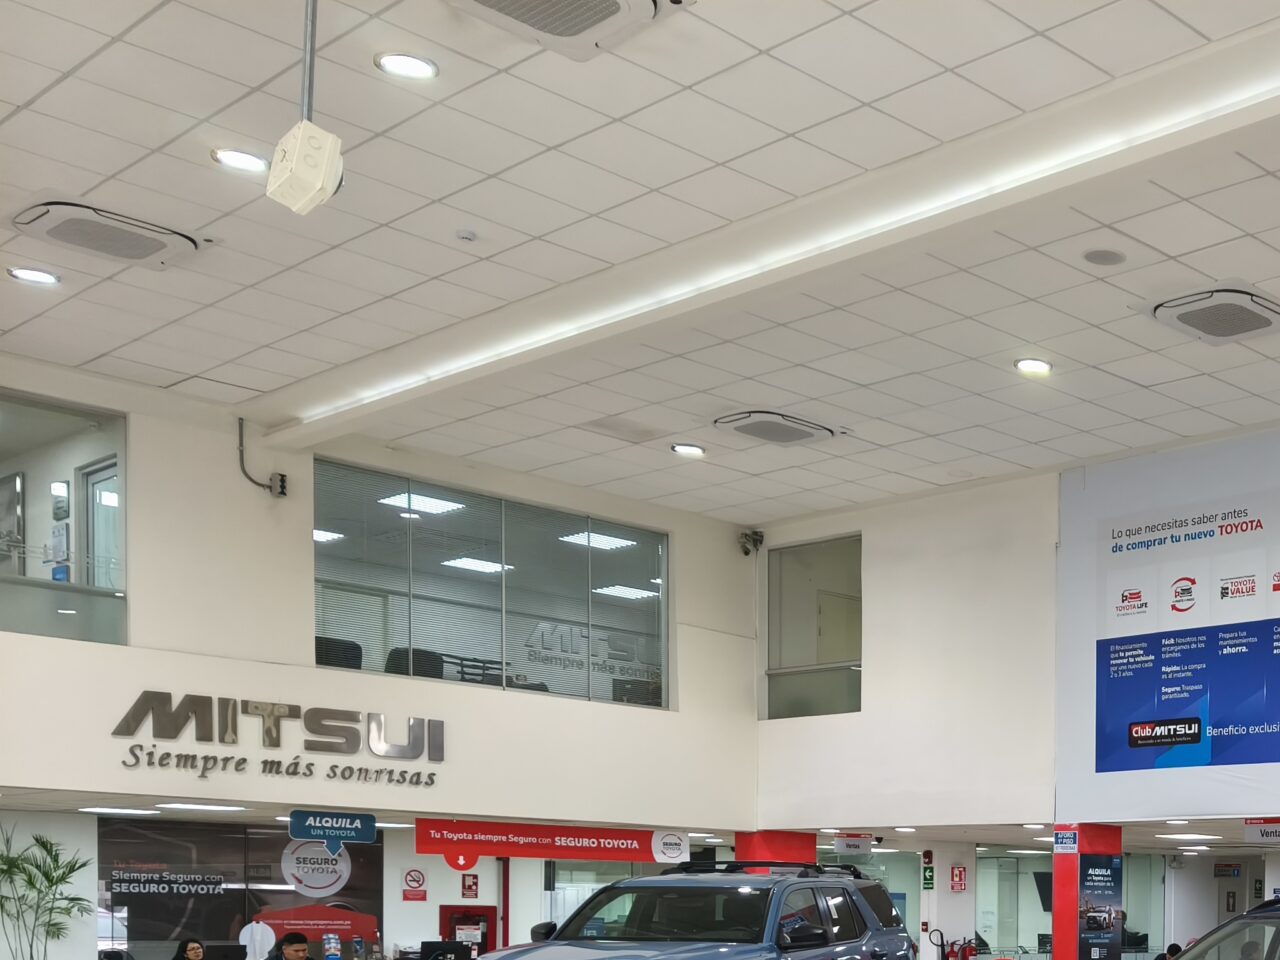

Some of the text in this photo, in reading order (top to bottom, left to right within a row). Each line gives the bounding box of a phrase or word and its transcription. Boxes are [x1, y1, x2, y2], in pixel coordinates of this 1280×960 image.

[1112, 508, 1249, 540] Lo que necesitas saber antes
[1112, 519, 1263, 553] de comprar tu nuevo TOYOTA
[1230, 579, 1256, 588] TOYOTA
[1230, 585, 1256, 596] VALUE
[1115, 603, 1136, 612] TOYOTA
[1219, 632, 1238, 640] Prepara
[1222, 646, 1249, 654] ahorra.
[1188, 663, 1206, 671] compra
[111, 690, 445, 762] MITSUI
[1206, 724, 1247, 737] Beneficio
[122, 744, 437, 787] Siempre más sonrisas
[305, 816, 362, 829] ALQUILA
[325, 829, 356, 837] TOYOTA
[429, 830, 639, 849] Tu Toyota siempre Seguro con SEGURO TOYOTA
[295, 857, 338, 866] SEGURO
[296, 866, 338, 875] TOYOTA
[1088, 867, 1111, 875] ALQUILA
[112, 870, 224, 883] Siempre Seguro con
[111, 883, 225, 894] SEGURO TOYOTA
